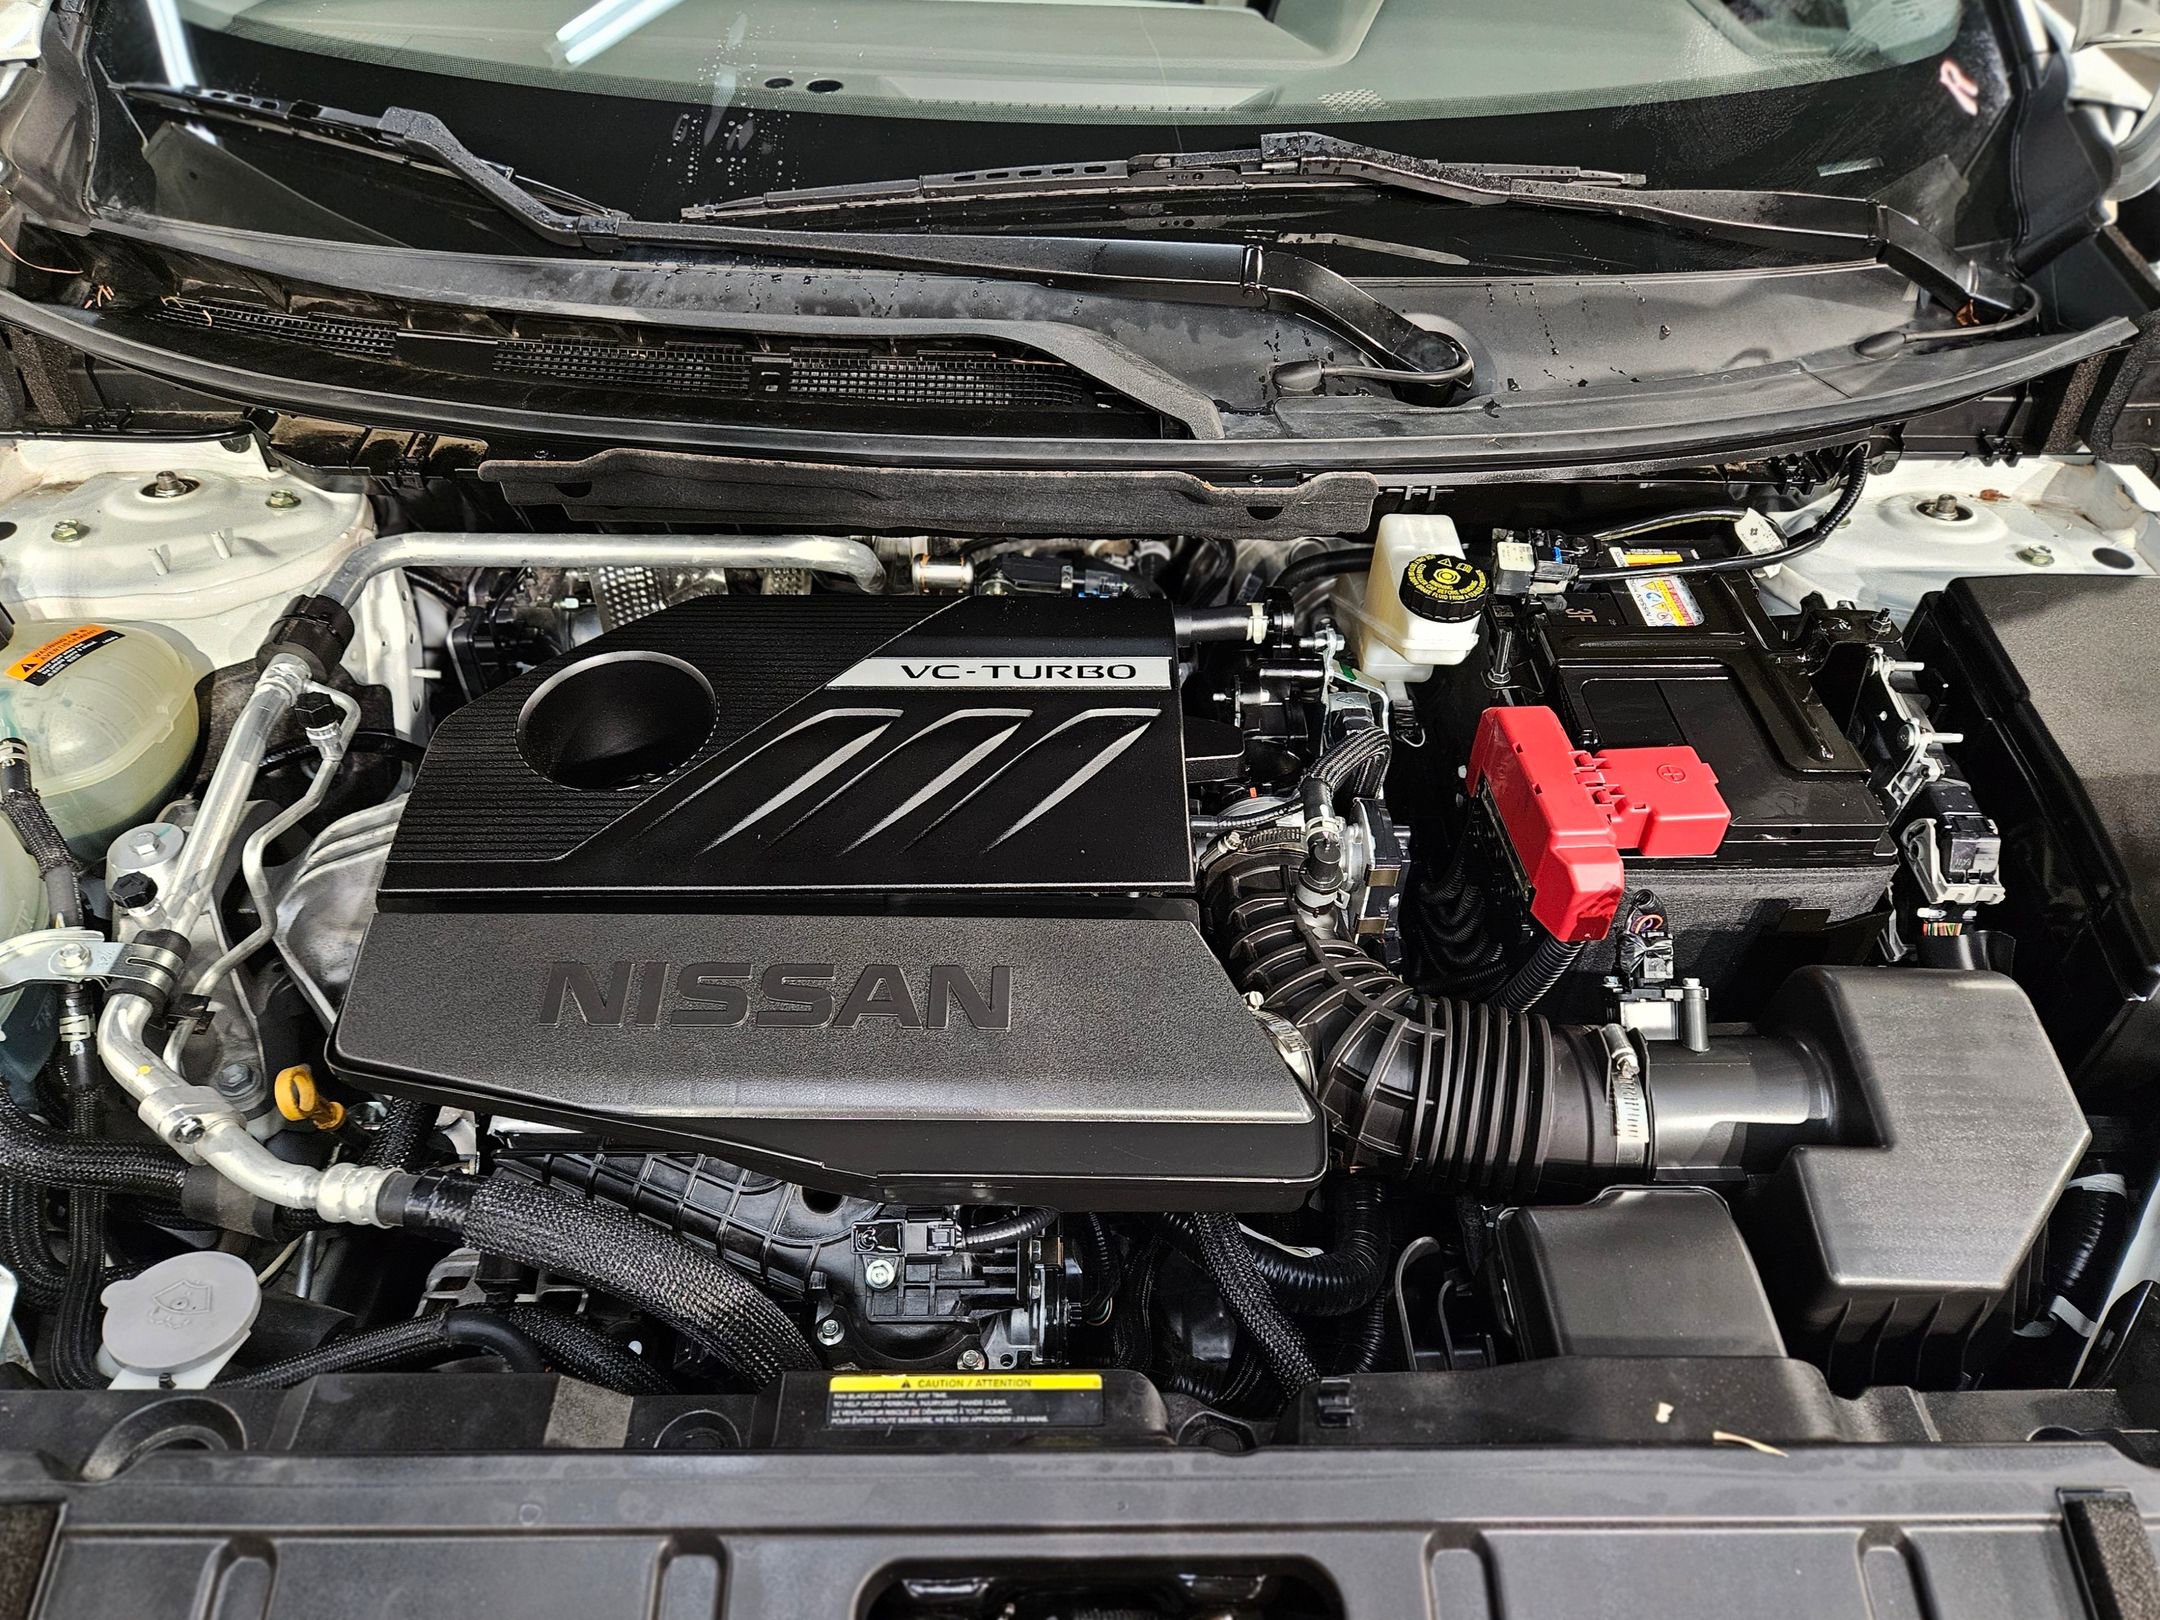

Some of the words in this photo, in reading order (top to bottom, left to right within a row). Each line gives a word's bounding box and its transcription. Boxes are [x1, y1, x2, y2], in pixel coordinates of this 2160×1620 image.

[900, 664, 1137, 680] VC-TURBO
[538, 961, 1013, 1031] NISSAN
[917, 1379, 964, 1389] CAUTION
[975, 1379, 1033, 1388] ATTENTION
